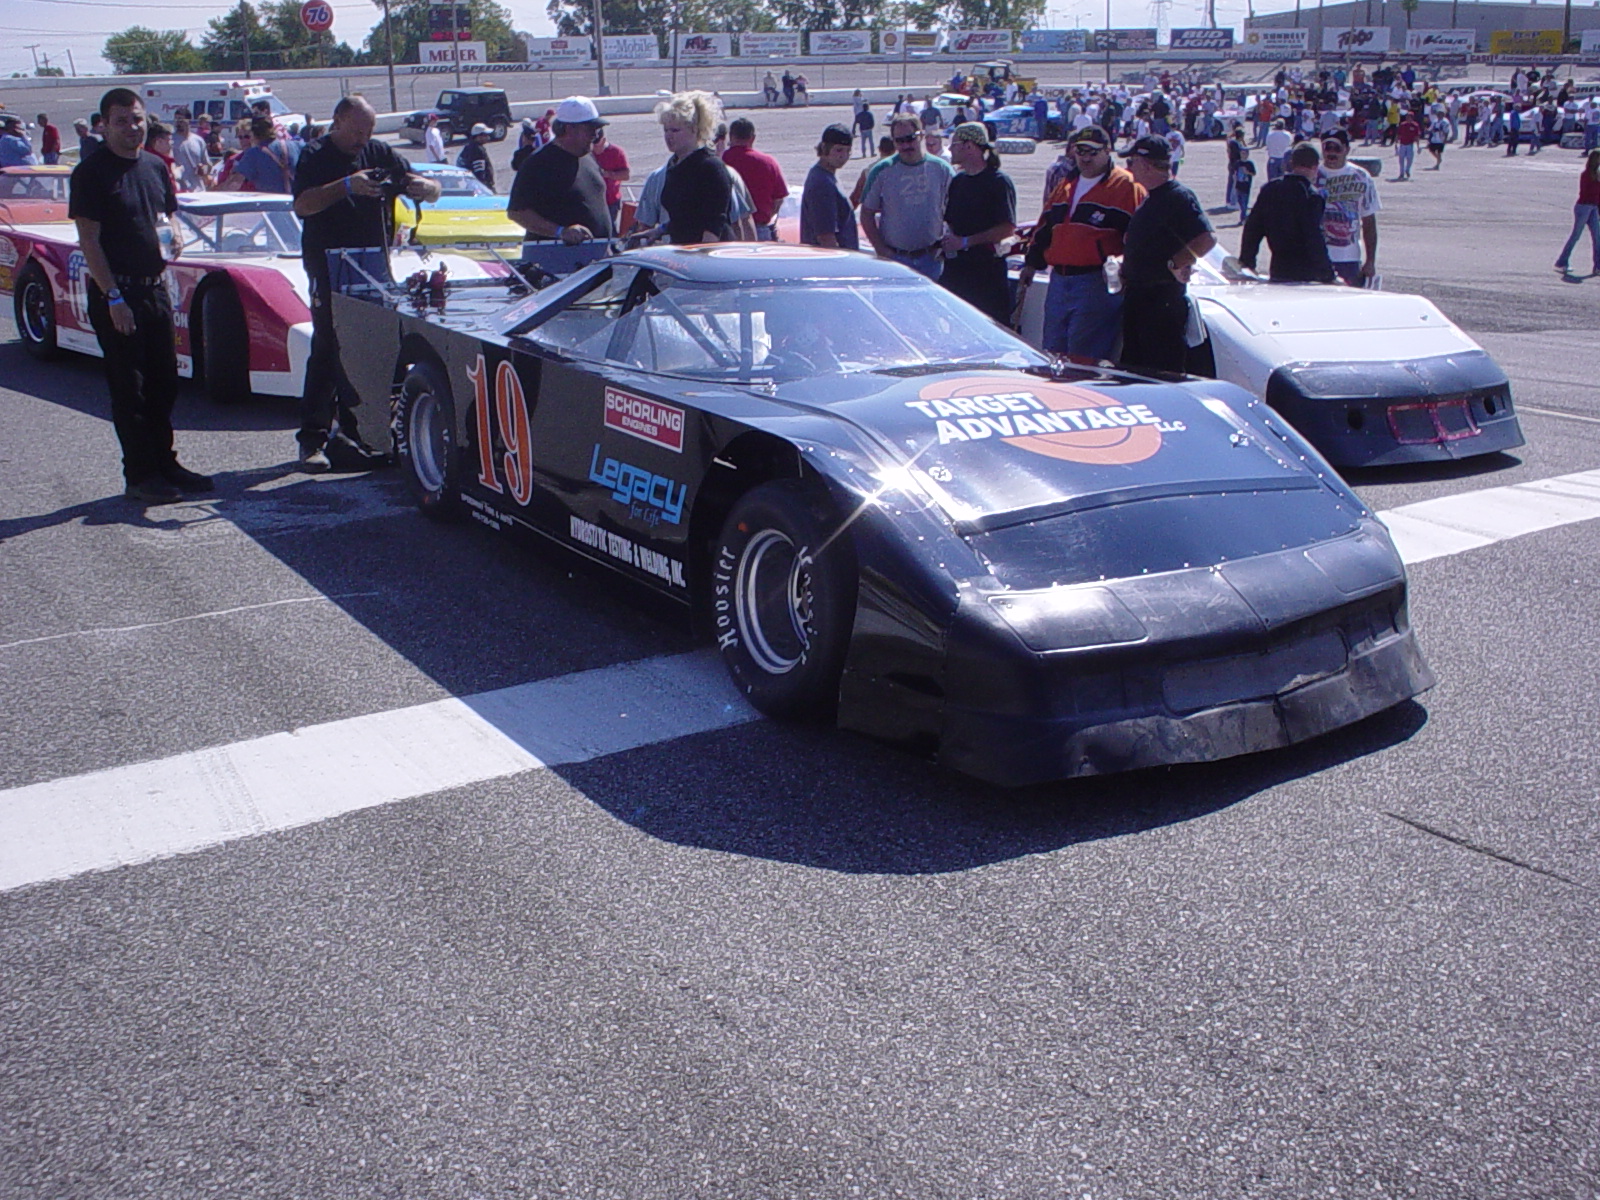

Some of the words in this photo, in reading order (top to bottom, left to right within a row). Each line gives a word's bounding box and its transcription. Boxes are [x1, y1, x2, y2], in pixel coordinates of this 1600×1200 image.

[306, 5, 331, 25] 76
[1173, 38, 1230, 47] LIGHT
[1182, 30, 1223, 39] BUD
[428, 48, 478, 61] MEIER
[1262, 50, 1297, 59] GROUP
[410, 65, 458, 74] TOLEDO
[462, 63, 532, 73] SPEEDWAY
[607, 392, 681, 432] SCHORLING
[905, 391, 1046, 419] TARGET
[466, 354, 533, 506] 19
[622, 415, 658, 437] ENGINES
[935, 404, 1162, 445] ADVANTAGE
[589, 443, 687, 525] Legacy
[714, 545, 739, 651] Hoosier
